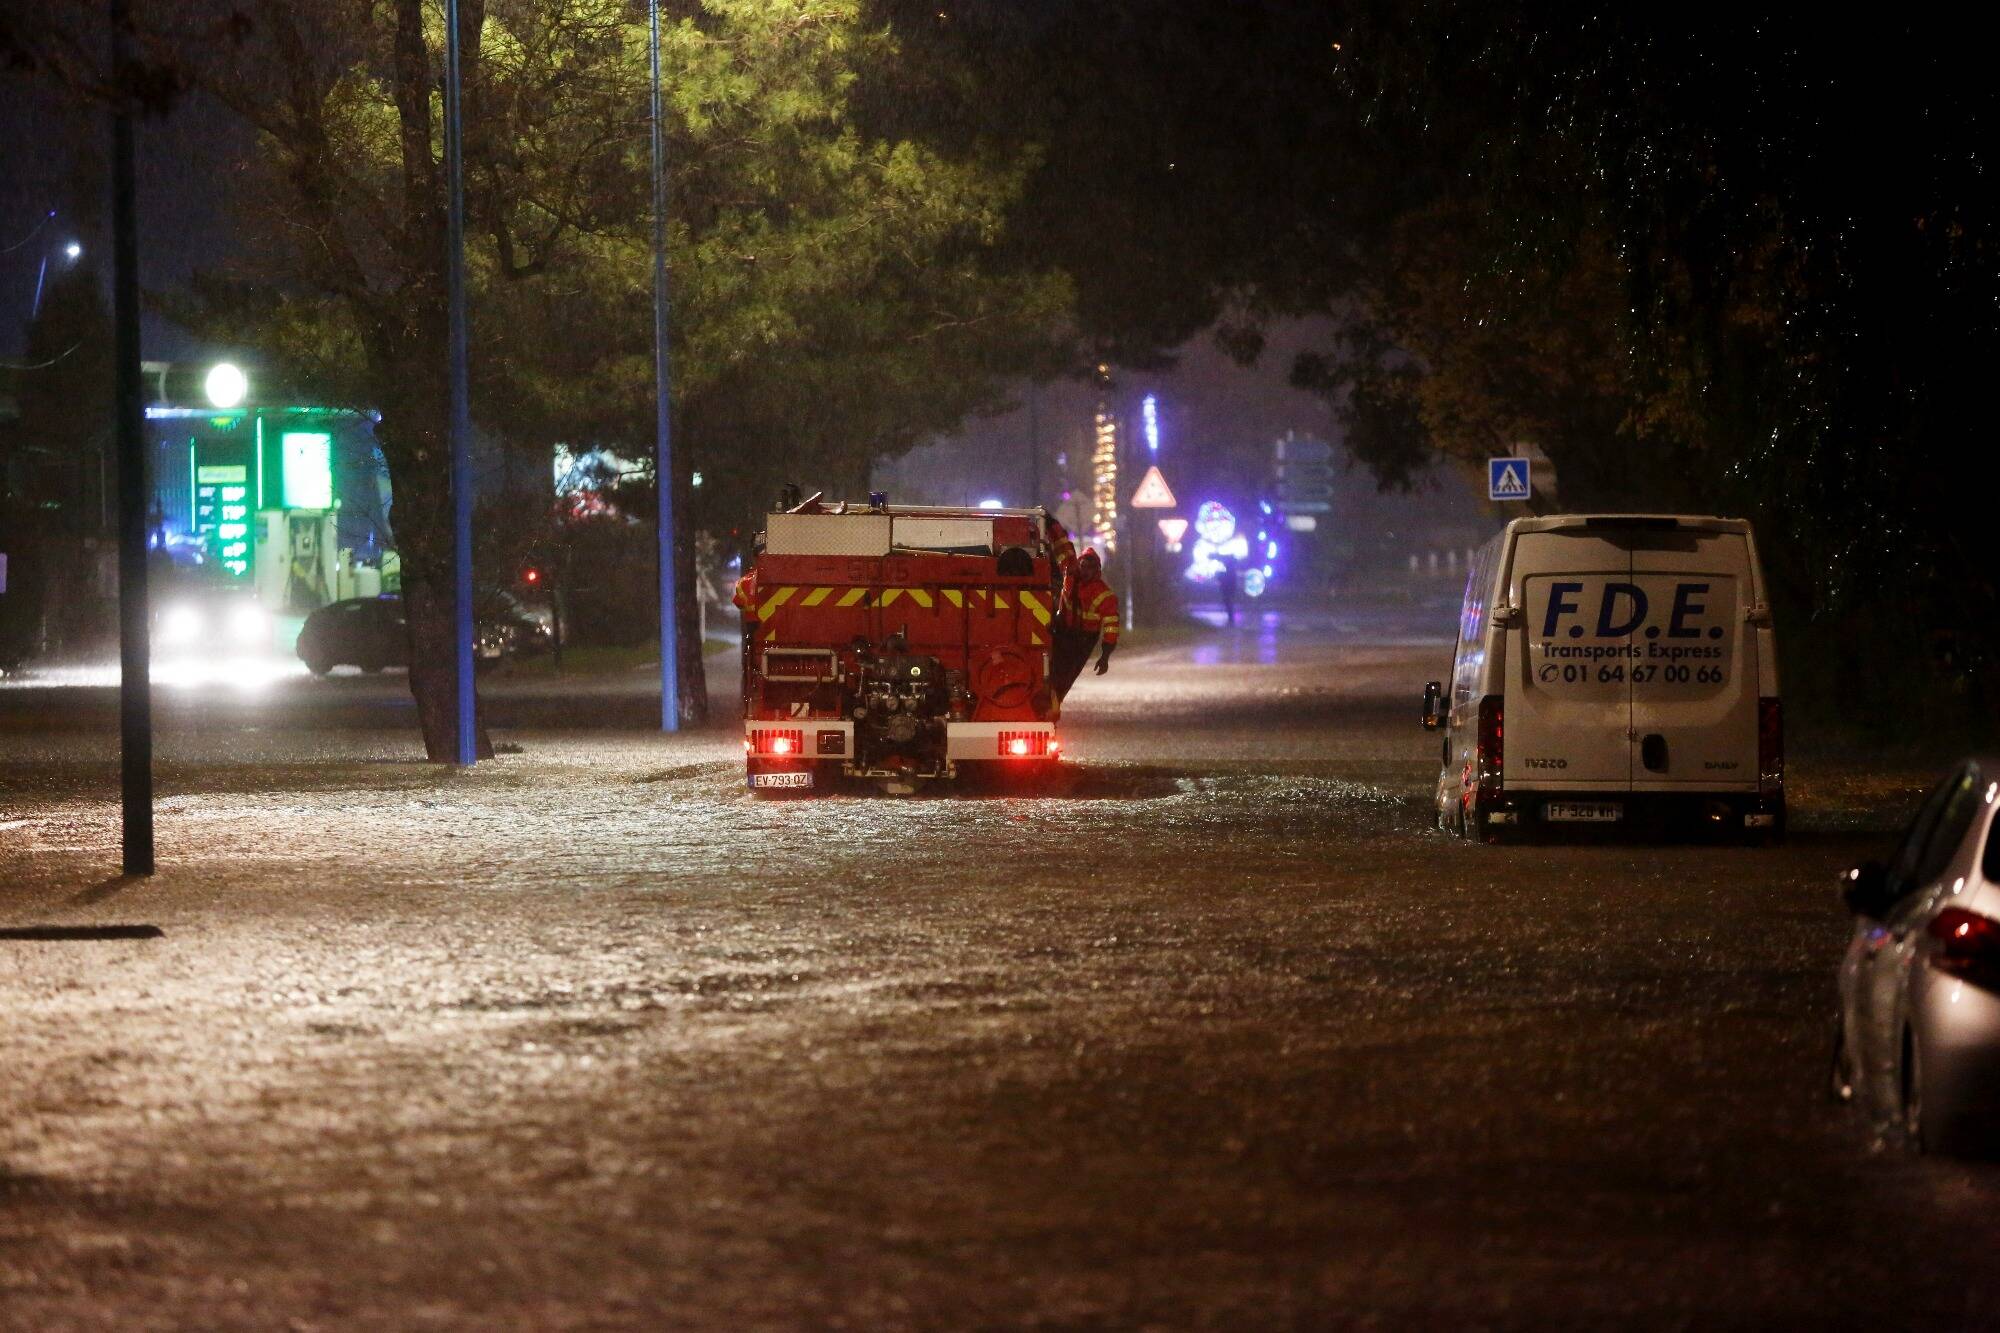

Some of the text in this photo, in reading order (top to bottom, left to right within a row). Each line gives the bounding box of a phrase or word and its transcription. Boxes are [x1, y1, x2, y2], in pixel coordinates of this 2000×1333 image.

[1542, 582, 1724, 639] F.D.E.
[1543, 642, 1722, 662] Transports Express
[1563, 664, 1723, 683] 01 64 67 00 66
